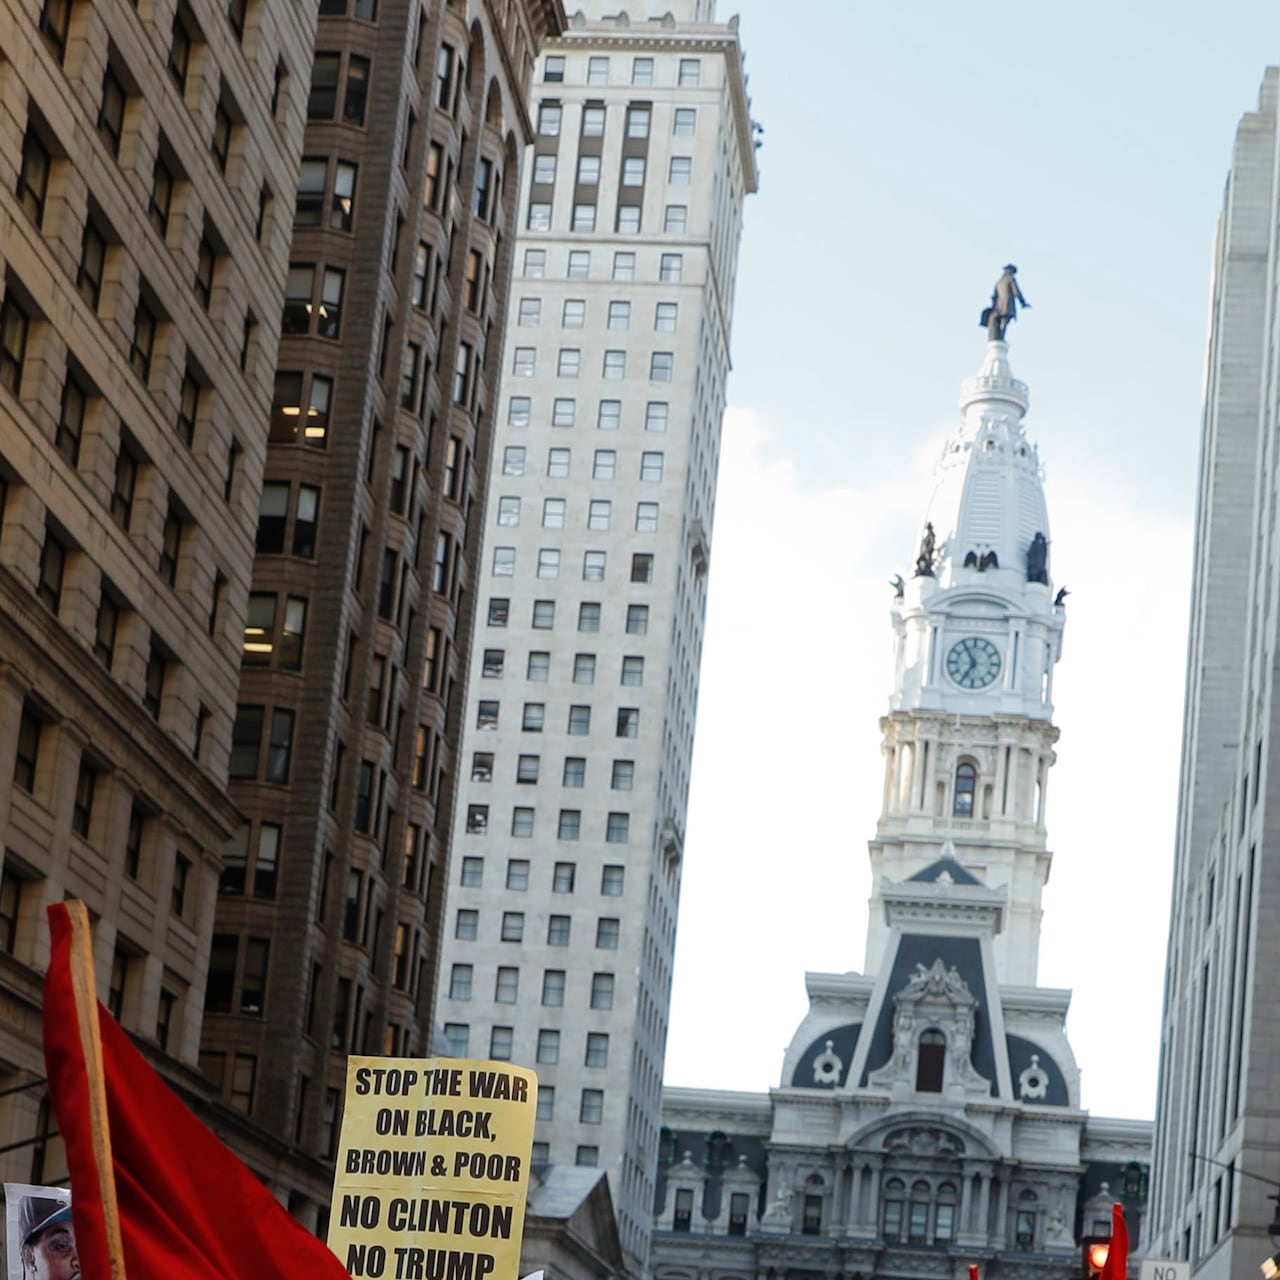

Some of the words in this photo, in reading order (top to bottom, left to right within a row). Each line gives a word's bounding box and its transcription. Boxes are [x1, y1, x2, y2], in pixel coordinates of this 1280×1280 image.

[356, 1068, 417, 1096] STOP
[424, 1069, 462, 1097] THE
[470, 1071, 528, 1102] WAR
[376, 1108, 409, 1136] ON
[415, 1109, 496, 1142] BLACK,
[345, 1149, 426, 1177] BROWN
[430, 1154, 447, 1177] &
[453, 1152, 521, 1182] POOR
[340, 1195, 380, 1229] NO
[388, 1198, 513, 1239] CLINTON
[347, 1244, 386, 1278] NO
